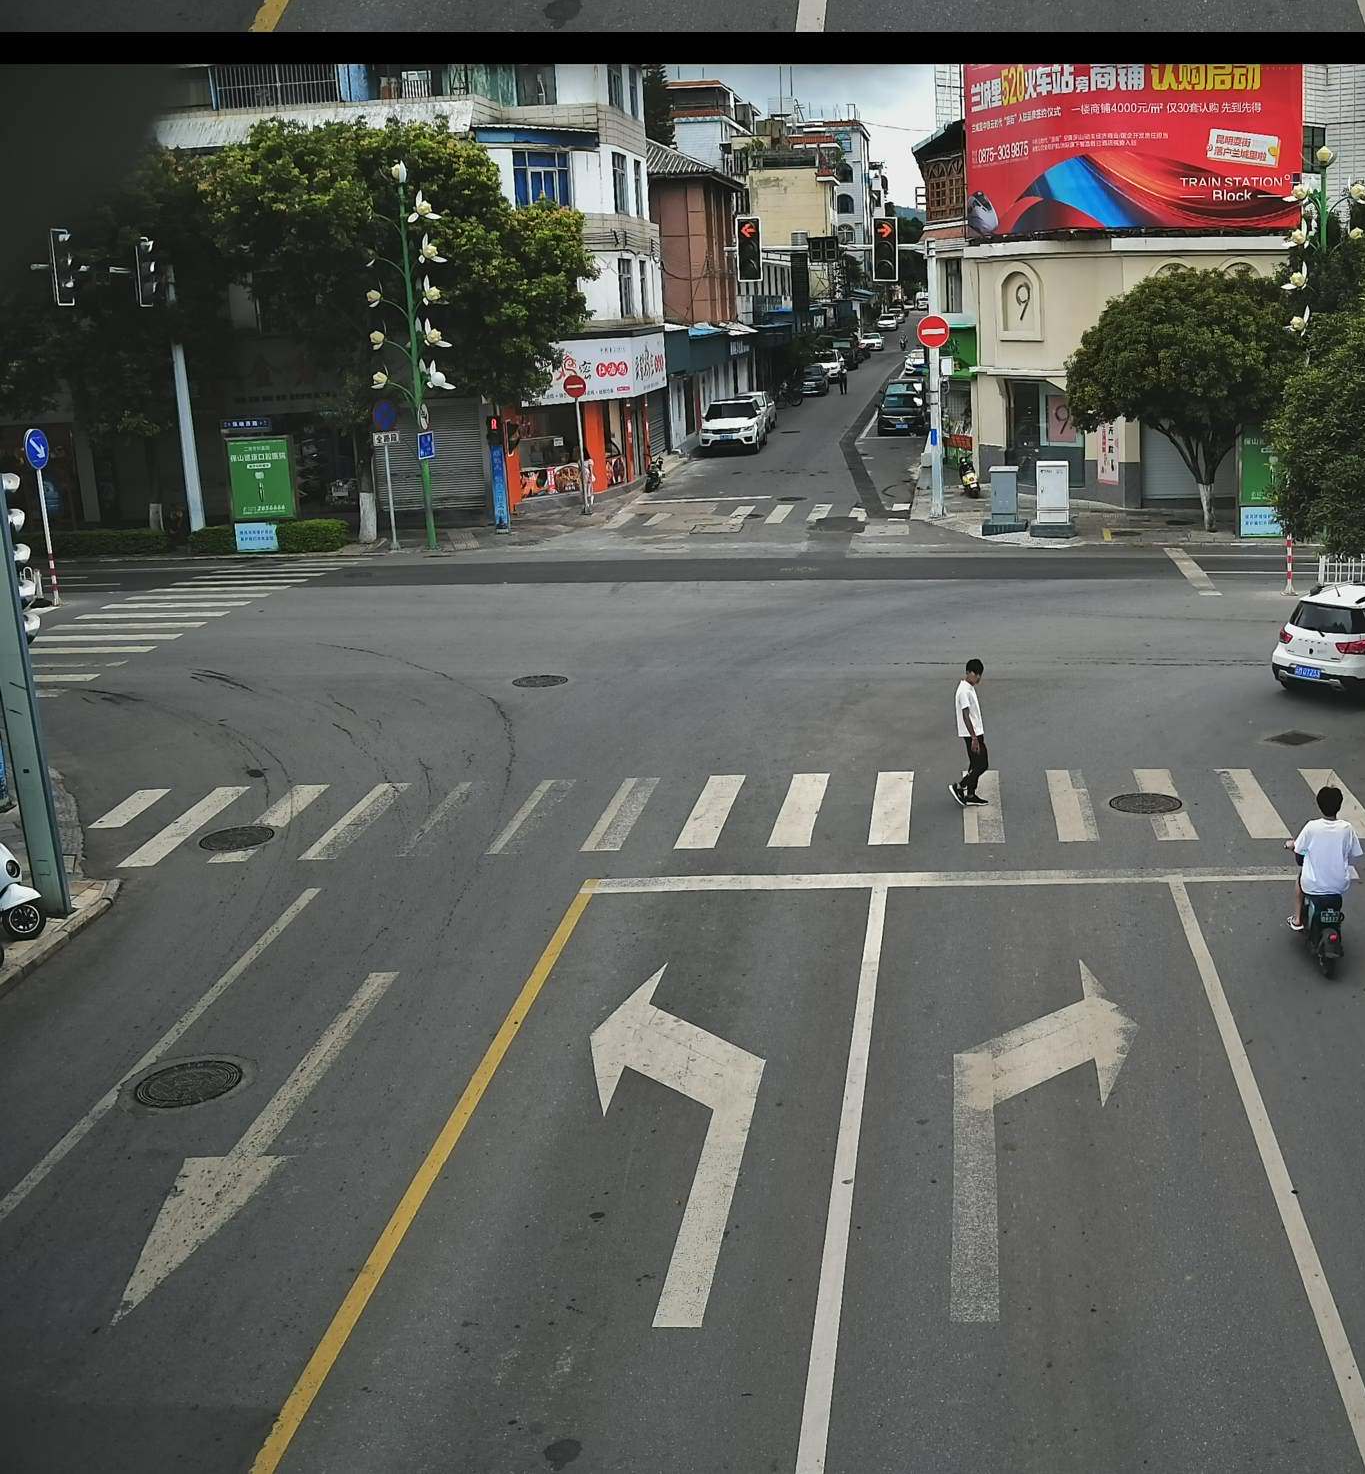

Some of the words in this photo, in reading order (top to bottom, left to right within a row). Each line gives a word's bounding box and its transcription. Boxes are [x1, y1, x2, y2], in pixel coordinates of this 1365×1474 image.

[1151, 64, 1263, 91] 认购启动
[1221, 102, 1263, 114] 先到先得
[1180, 177, 1221, 188] TRAIN
[1224, 176, 1283, 188] STATION
[1212, 189, 1252, 201] Block
